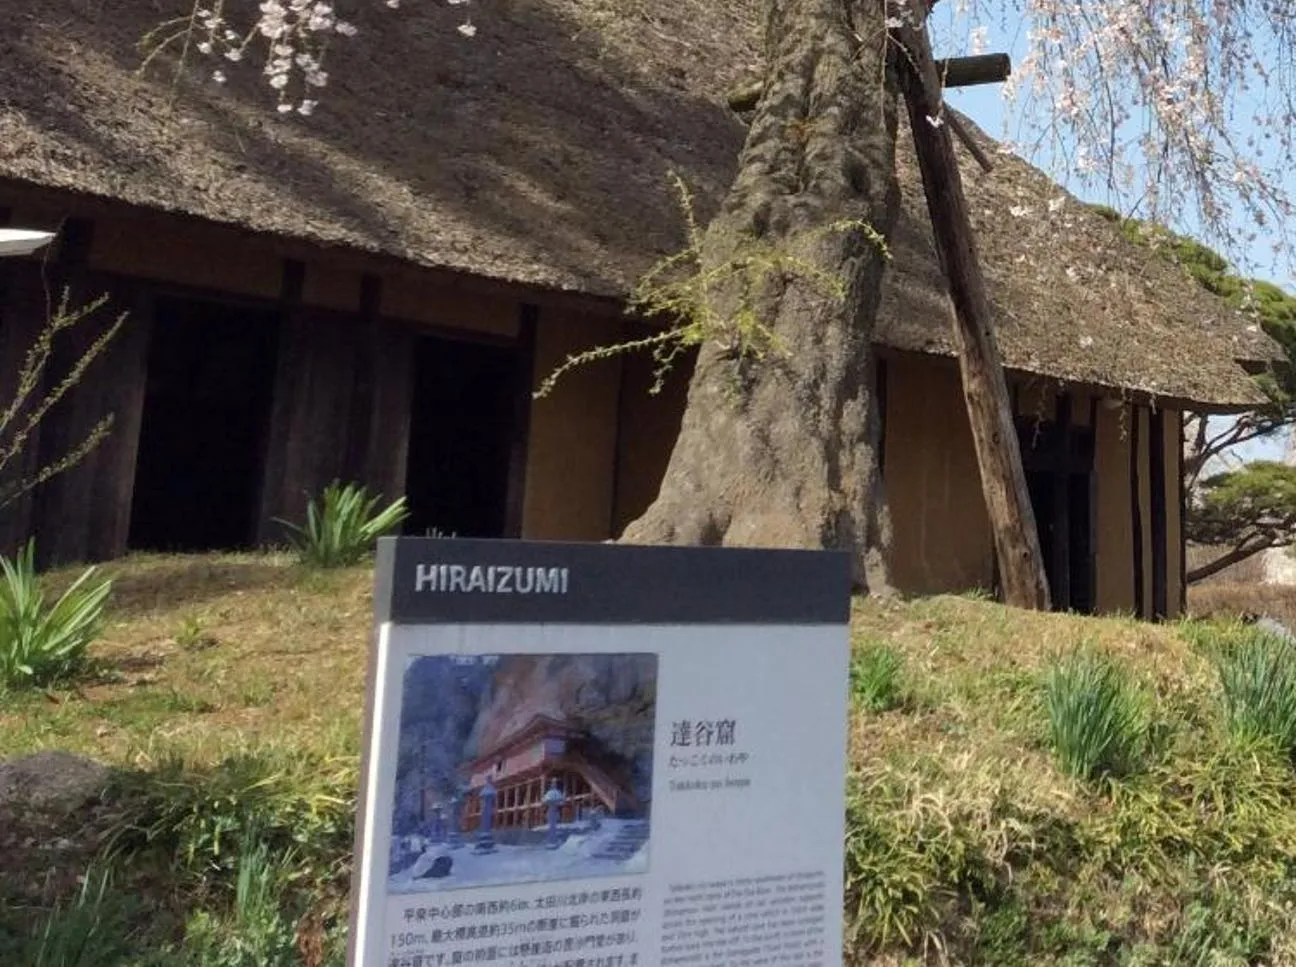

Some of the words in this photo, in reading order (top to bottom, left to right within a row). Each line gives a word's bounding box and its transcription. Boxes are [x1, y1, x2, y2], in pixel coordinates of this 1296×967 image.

[415, 563, 569, 594] HIRAIZUMI
[670, 719, 736, 746] 達谷窟
